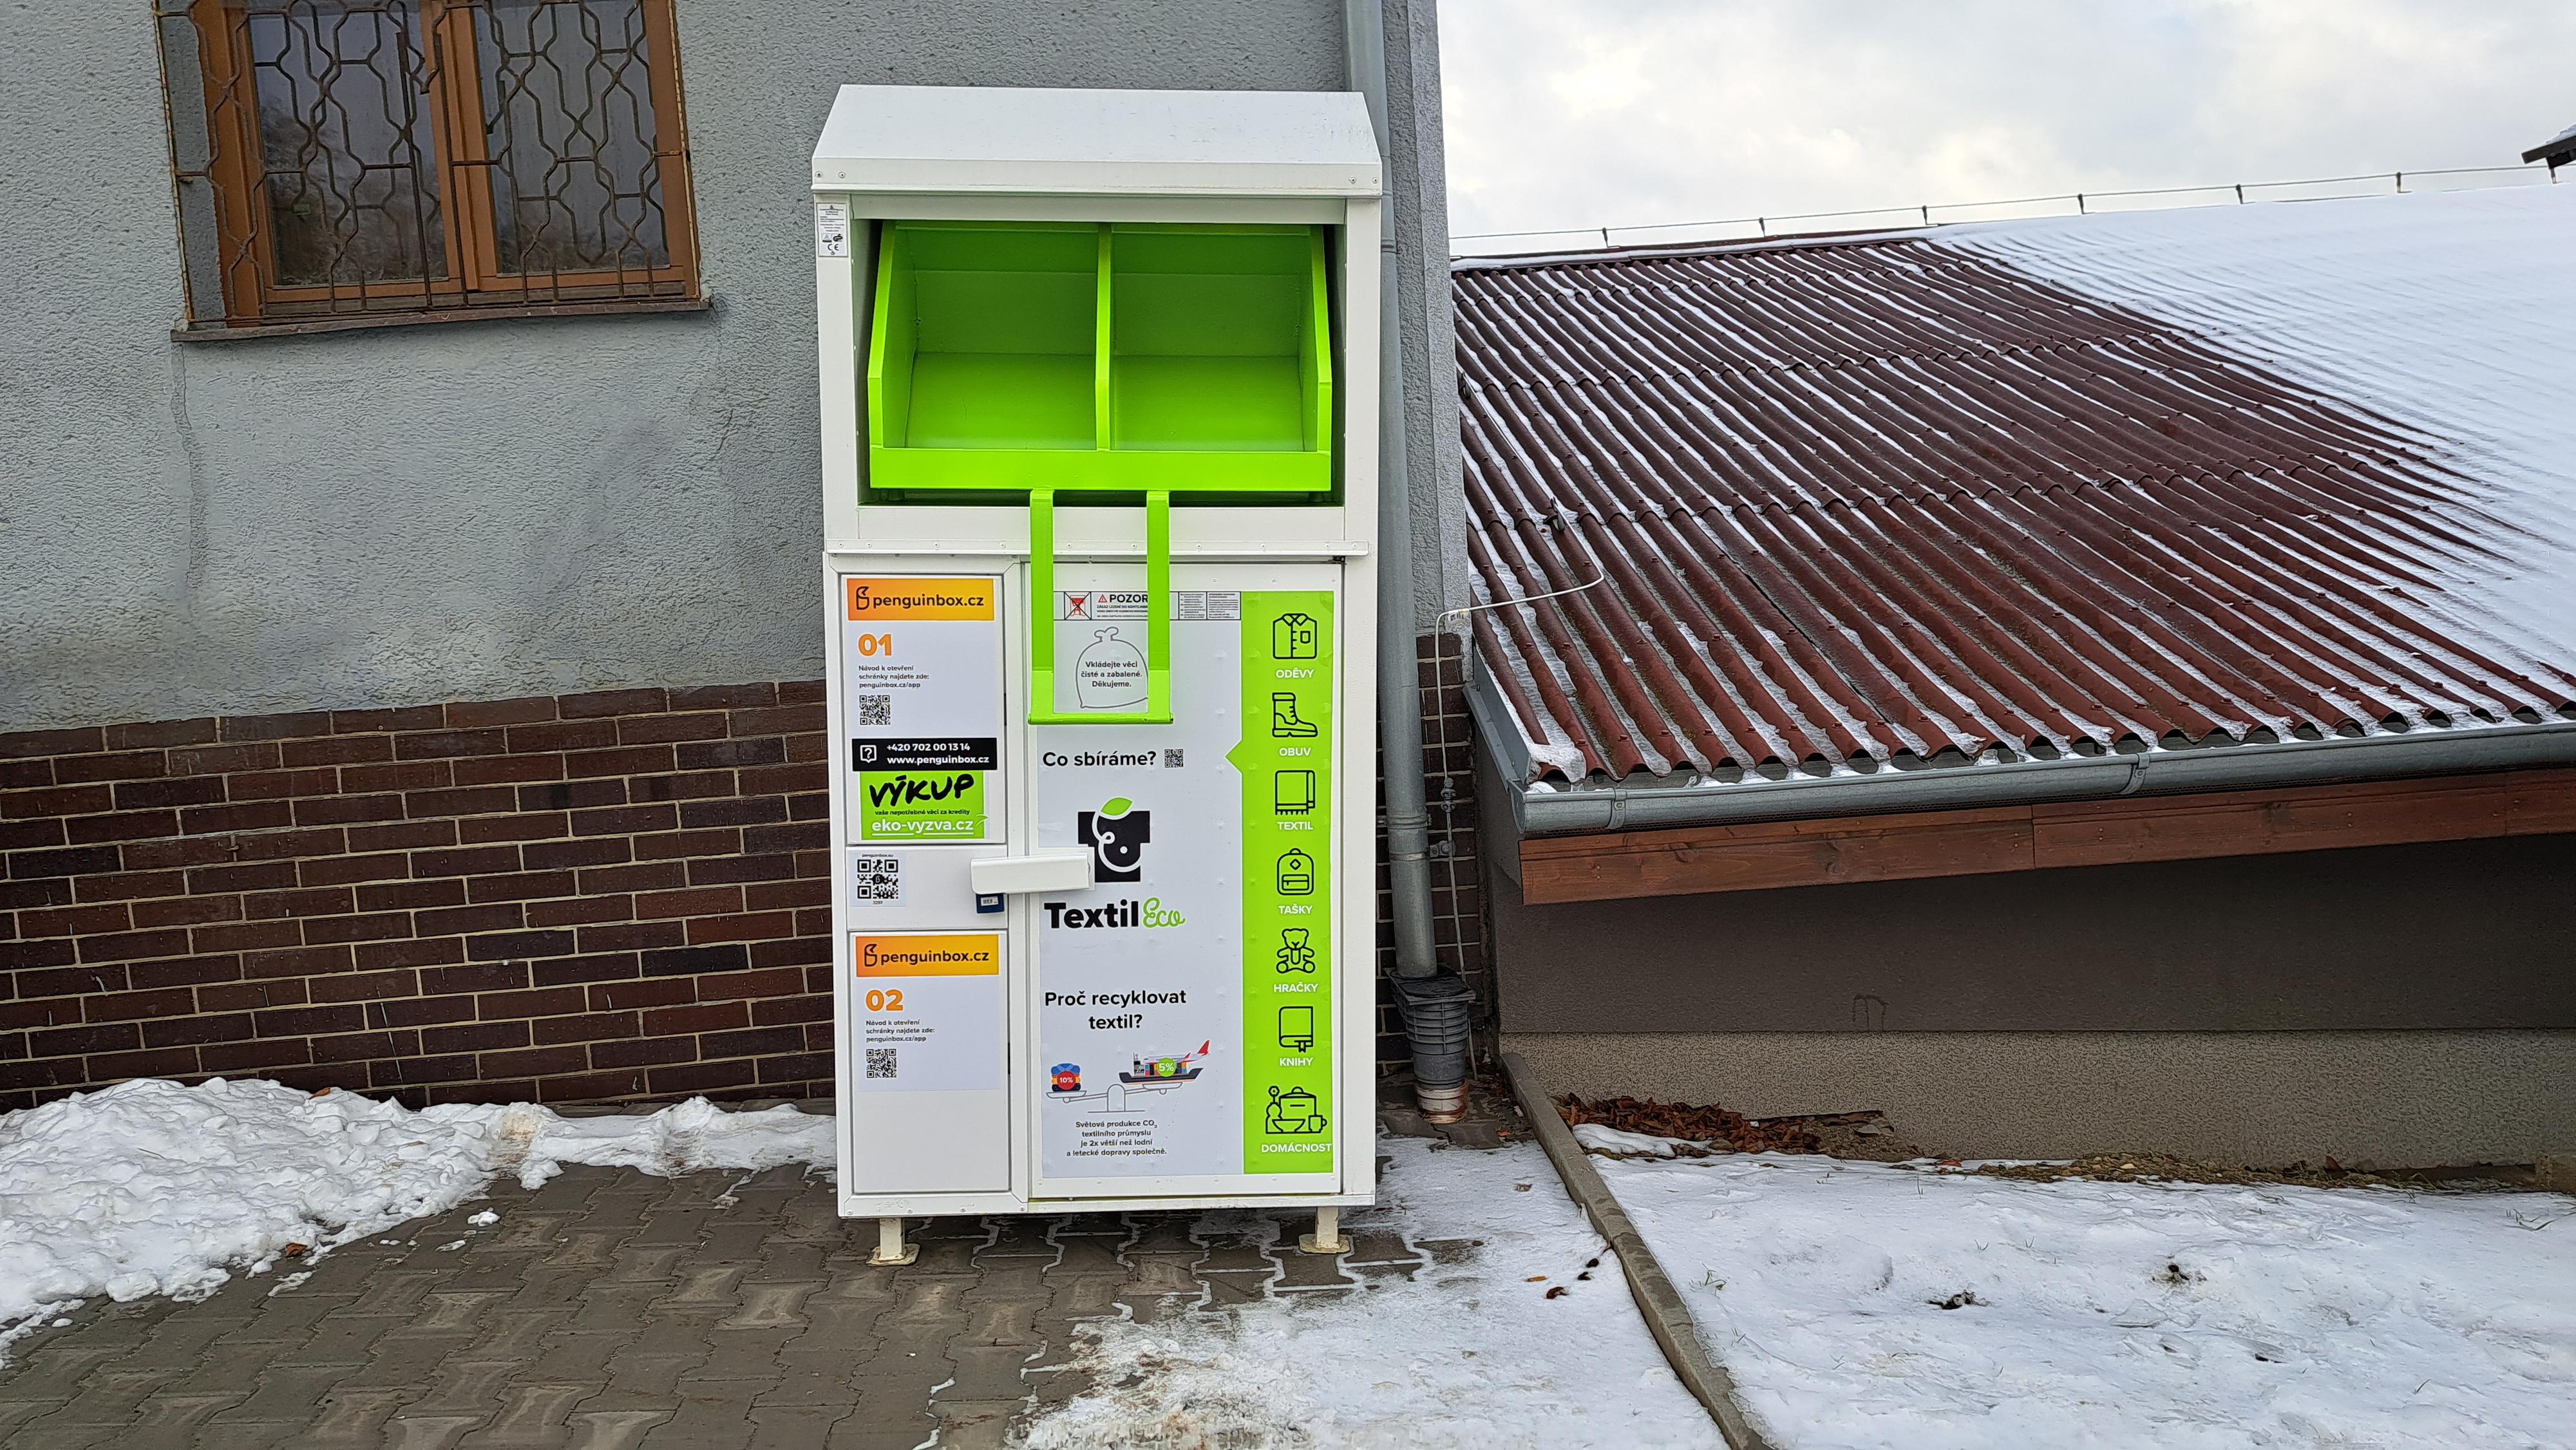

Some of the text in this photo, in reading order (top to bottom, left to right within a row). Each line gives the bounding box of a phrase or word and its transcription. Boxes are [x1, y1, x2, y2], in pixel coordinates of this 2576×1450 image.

[873, 594, 984, 609] penguinbox.cz
[858, 634, 892, 656] 01
[1276, 668, 1314, 679] ODĚVY
[1092, 680, 1132, 688] Děkujeme.
[1279, 748, 1311, 757] OBUV
[887, 755, 990, 766] www.penguinbox.cz
[1043, 751, 1157, 766] Co sbíráme?
[869, 774, 974, 807] VÝKUP
[872, 819, 974, 833] eko-vyzva.cz
[1277, 822, 1313, 830] TEXTIL
[1278, 903, 1313, 915] TAŠKY
[881, 950, 989, 965] penguinbox.cz
[1273, 982, 1318, 993] HRAČKY
[866, 989, 904, 1012] 02
[1045, 990, 1186, 1008] Proč recyklovat
[1088, 1014, 1142, 1029] textil?
[1159, 1063, 1174, 1071] 5%
[1280, 1057, 1313, 1066] KNIHY
[1118, 1129, 1151, 1138] průmyslu
[1101, 1149, 1130, 1157] dopravy
[1132, 1148, 1167, 1156] společně.
[1261, 1142, 1332, 1153] DOMÁCNOST
